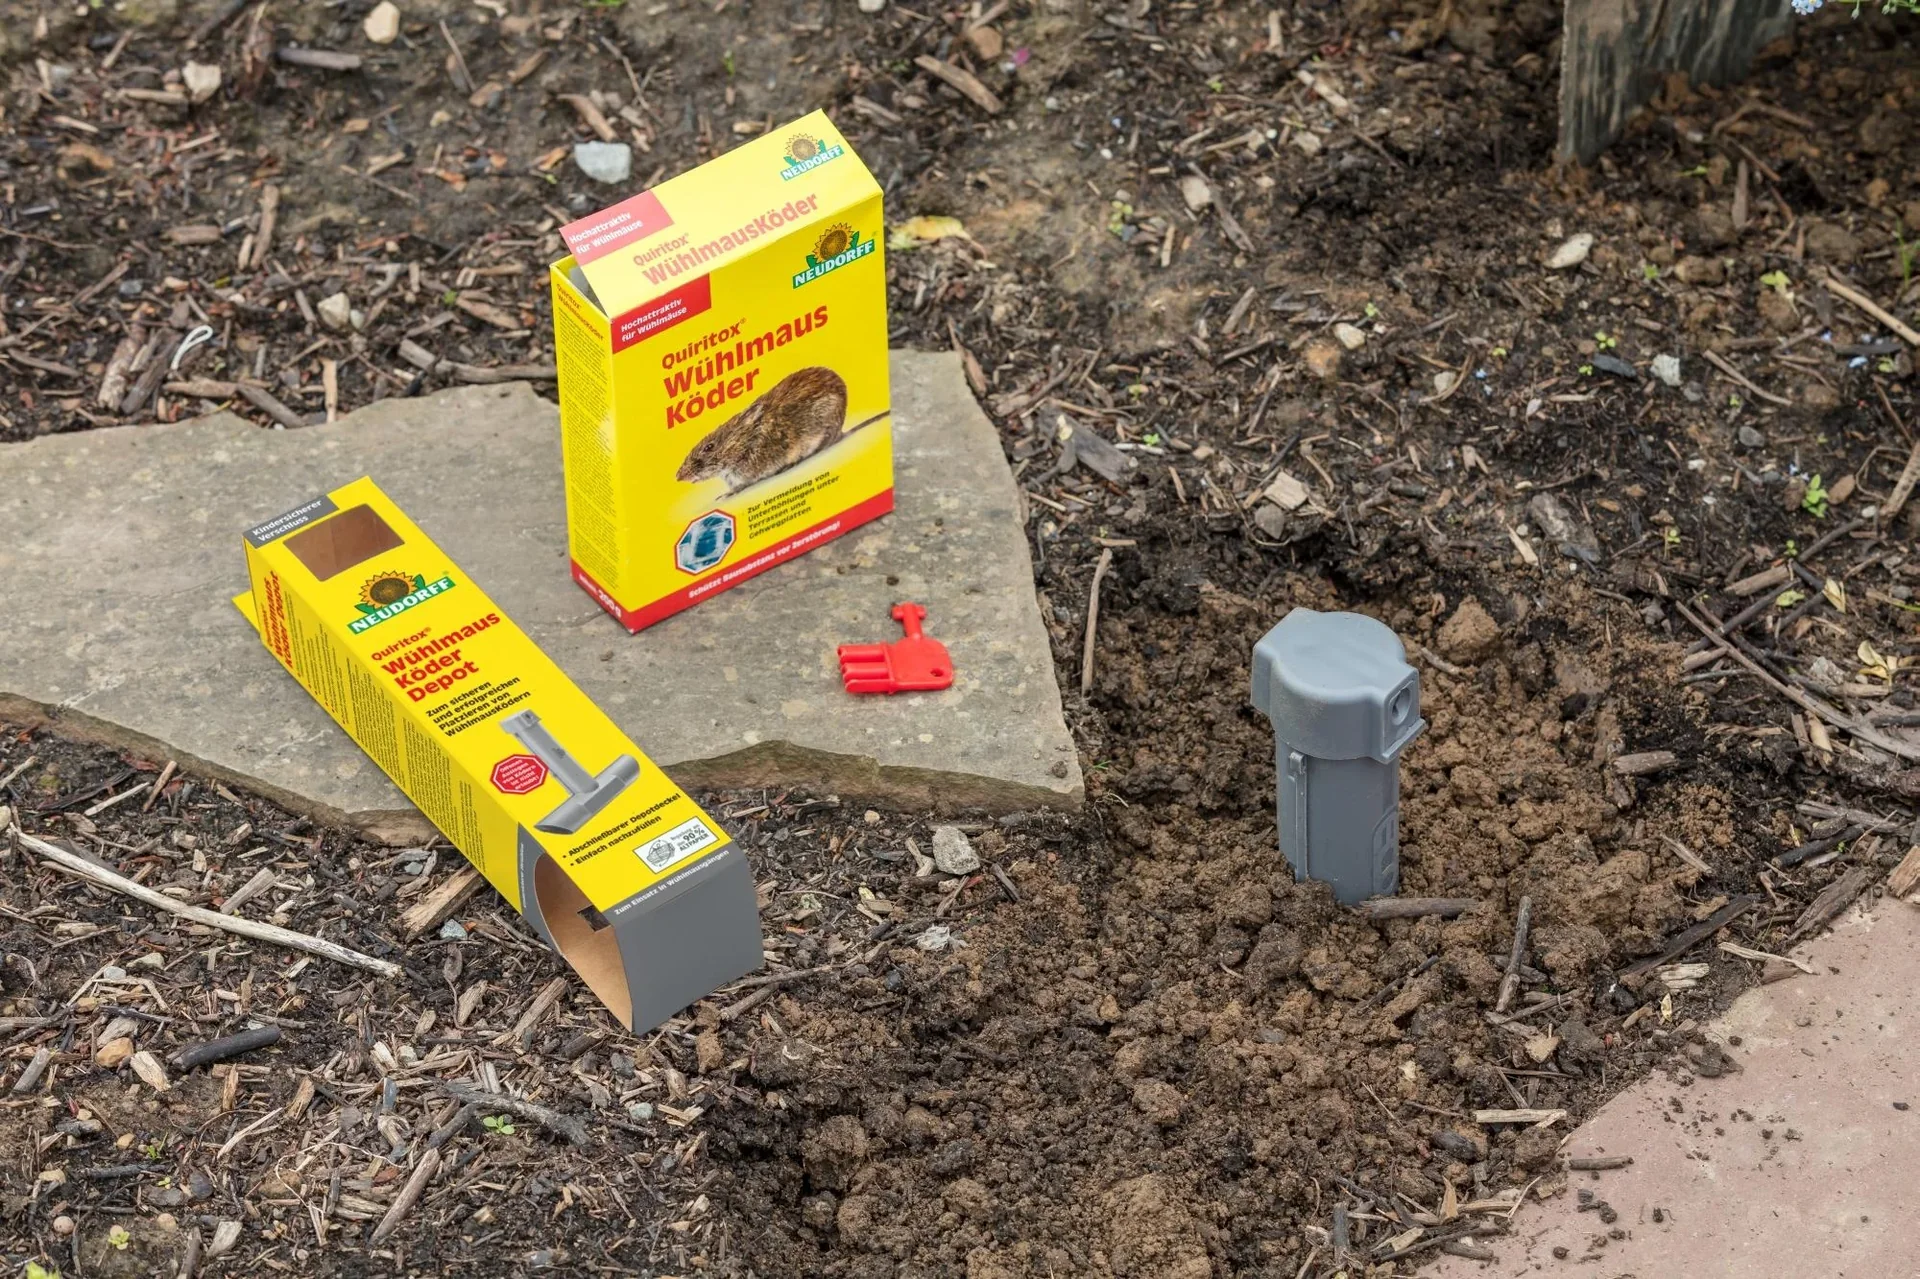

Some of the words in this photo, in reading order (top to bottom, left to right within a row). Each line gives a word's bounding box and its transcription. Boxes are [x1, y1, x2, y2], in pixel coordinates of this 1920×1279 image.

[782, 146, 843, 180] NEUDORFF
[569, 211, 632, 244] Hochattraktiv
[576, 243, 591, 254] für
[592, 219, 644, 248] Wühlmäuse
[641, 193, 818, 286] WühlmausKöder
[794, 239, 874, 287] NEUDORFF
[621, 298, 682, 332] Hochattraktiv
[621, 331, 636, 342] für
[637, 306, 688, 334] Wühlmäuse
[663, 304, 829, 399] Wühlmaus
[665, 367, 760, 430] Köder
[747, 503, 761, 514] Zur
[763, 479, 813, 506] Vermeidung
[814, 471, 830, 482] von
[816, 475, 840, 490] unter
[251, 499, 323, 537] Kindersicherer
[257, 514, 309, 543] Verschluss
[748, 508, 788, 531] Terrassen
[790, 499, 807, 511] und
[749, 506, 812, 539] Gehwegplatten
[688, 576, 722, 599] Schützt
[723, 551, 776, 583] Bausubstanz
[776, 544, 791, 557] vor
[791, 520, 841, 549] Zerstörung!
[350, 577, 451, 633] NEUDORFF
[380, 612, 501, 675] Wühlmaus
[393, 648, 462, 690] Köder
[406, 660, 480, 703] Depot
[425, 703, 449, 718] Zum
[449, 681, 492, 706] sicheren
[432, 710, 454, 724] und
[454, 676, 521, 713] erfolgreichen
[438, 702, 491, 731] Platzieren
[490, 691, 511, 704] von
[444, 690, 532, 737] WühlmausKödern
[567, 819, 629, 857] Abschließbarer
[629, 792, 682, 824] Depotdeckel
[574, 843, 608, 865] Einfach
[607, 814, 662, 848] nachzufüllen
[613, 903, 632, 916] Zum
[631, 888, 659, 906] Einsatz
[658, 883, 667, 891] in
[666, 849, 730, 886] Wühlmausgängen
